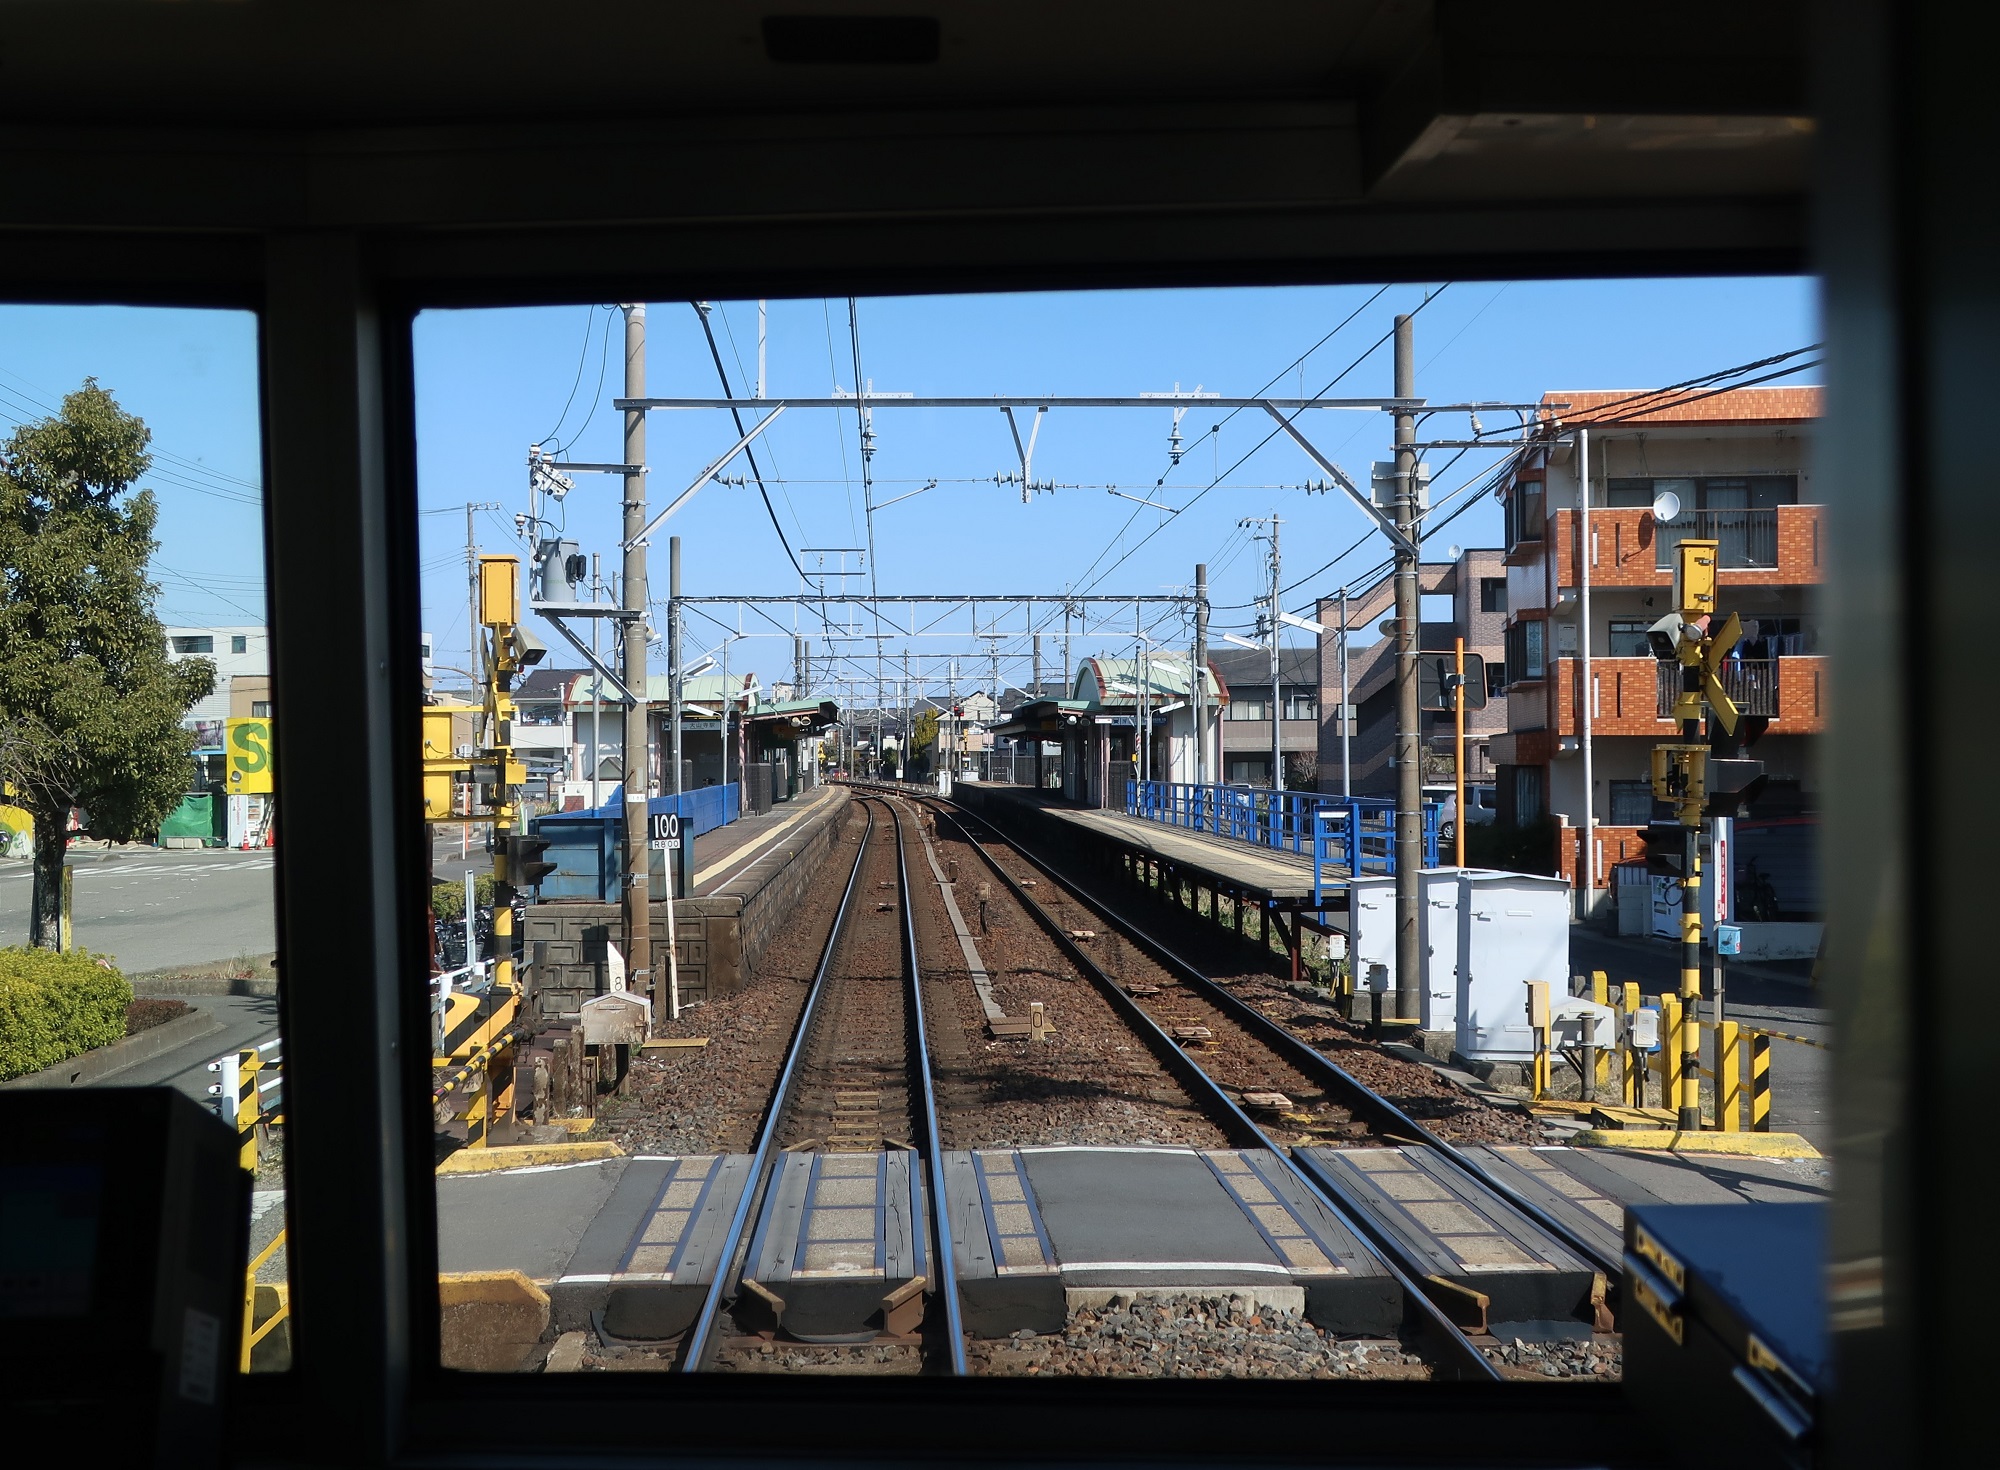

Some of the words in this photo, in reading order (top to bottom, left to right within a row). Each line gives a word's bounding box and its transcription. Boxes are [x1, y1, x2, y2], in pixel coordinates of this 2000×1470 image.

[232, 722, 273, 774] S
[654, 814, 678, 838] 100
[654, 840, 679, 849] R800
